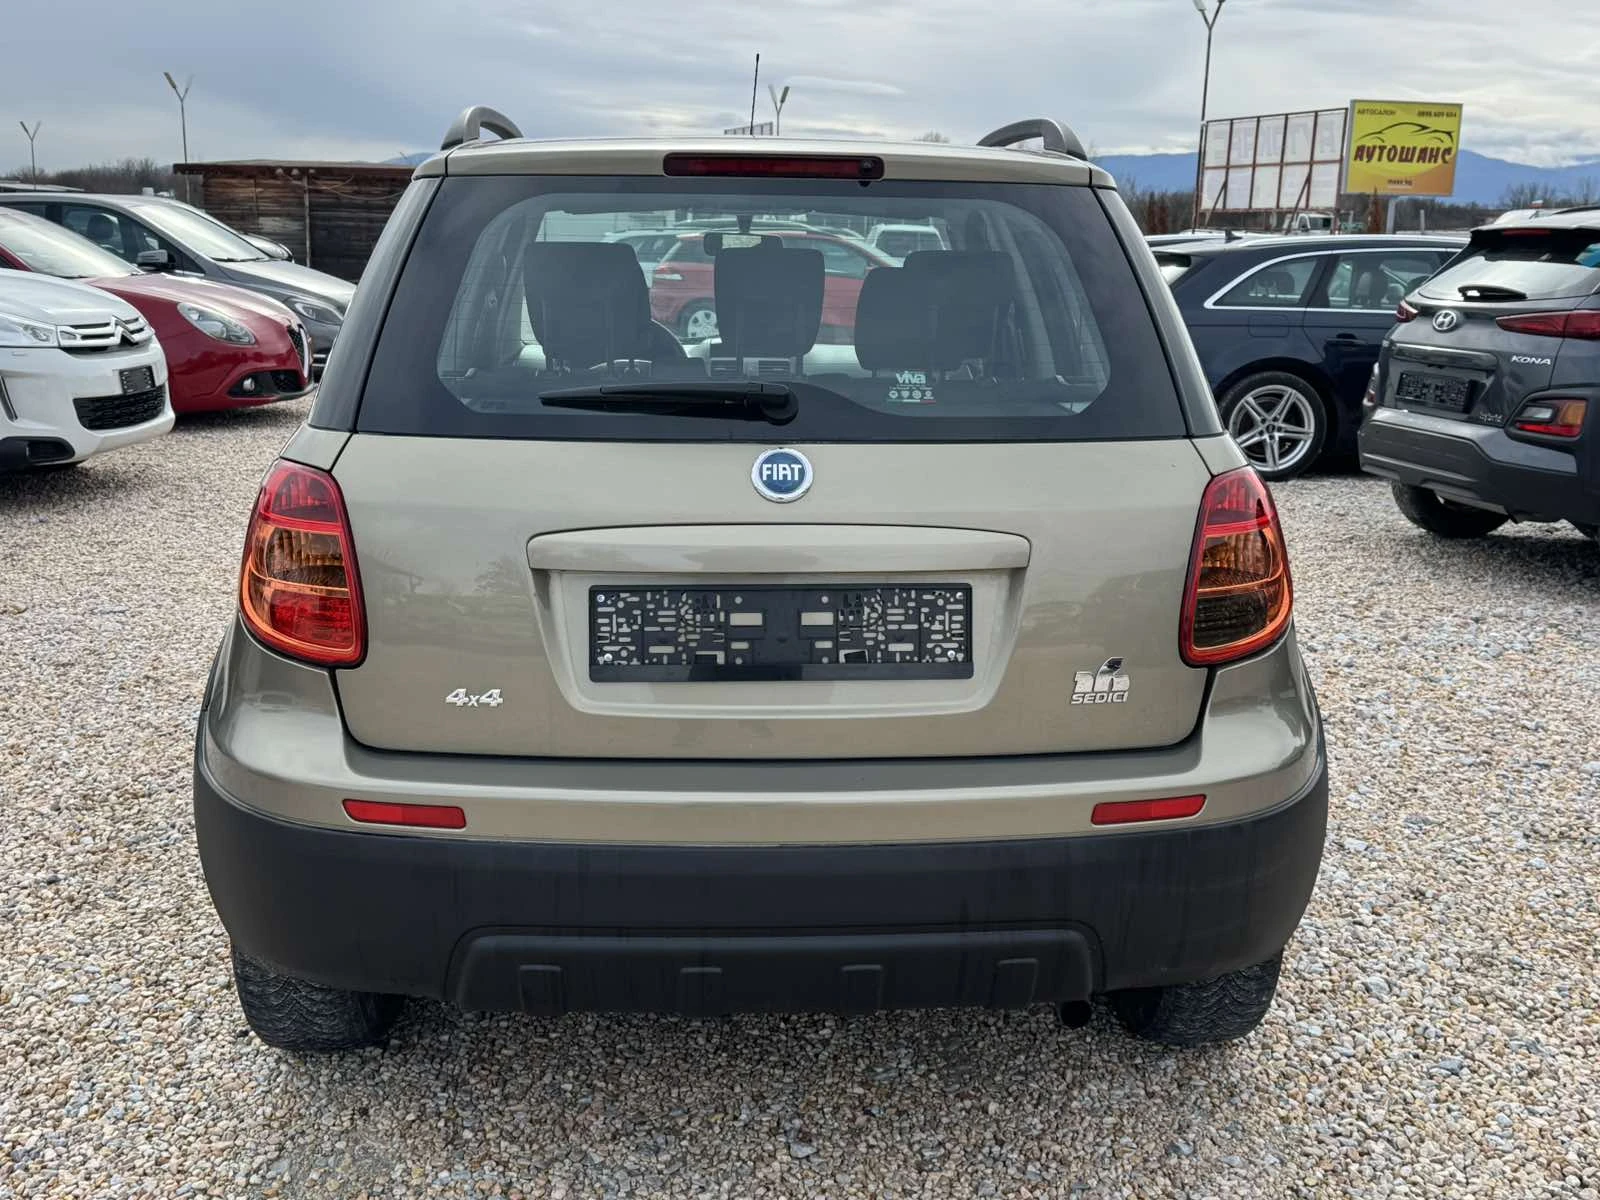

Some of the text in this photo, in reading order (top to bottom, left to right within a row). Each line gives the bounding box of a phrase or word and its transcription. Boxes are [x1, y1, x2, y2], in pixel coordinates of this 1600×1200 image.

[1353, 144, 1453, 164] АУТОШАНС
[1511, 355, 1551, 365] KONA
[895, 370, 926, 384] viva
[762, 463, 803, 481] FIAT
[445, 687, 504, 708] 4x4
[1070, 690, 1129, 704] SEDICI
